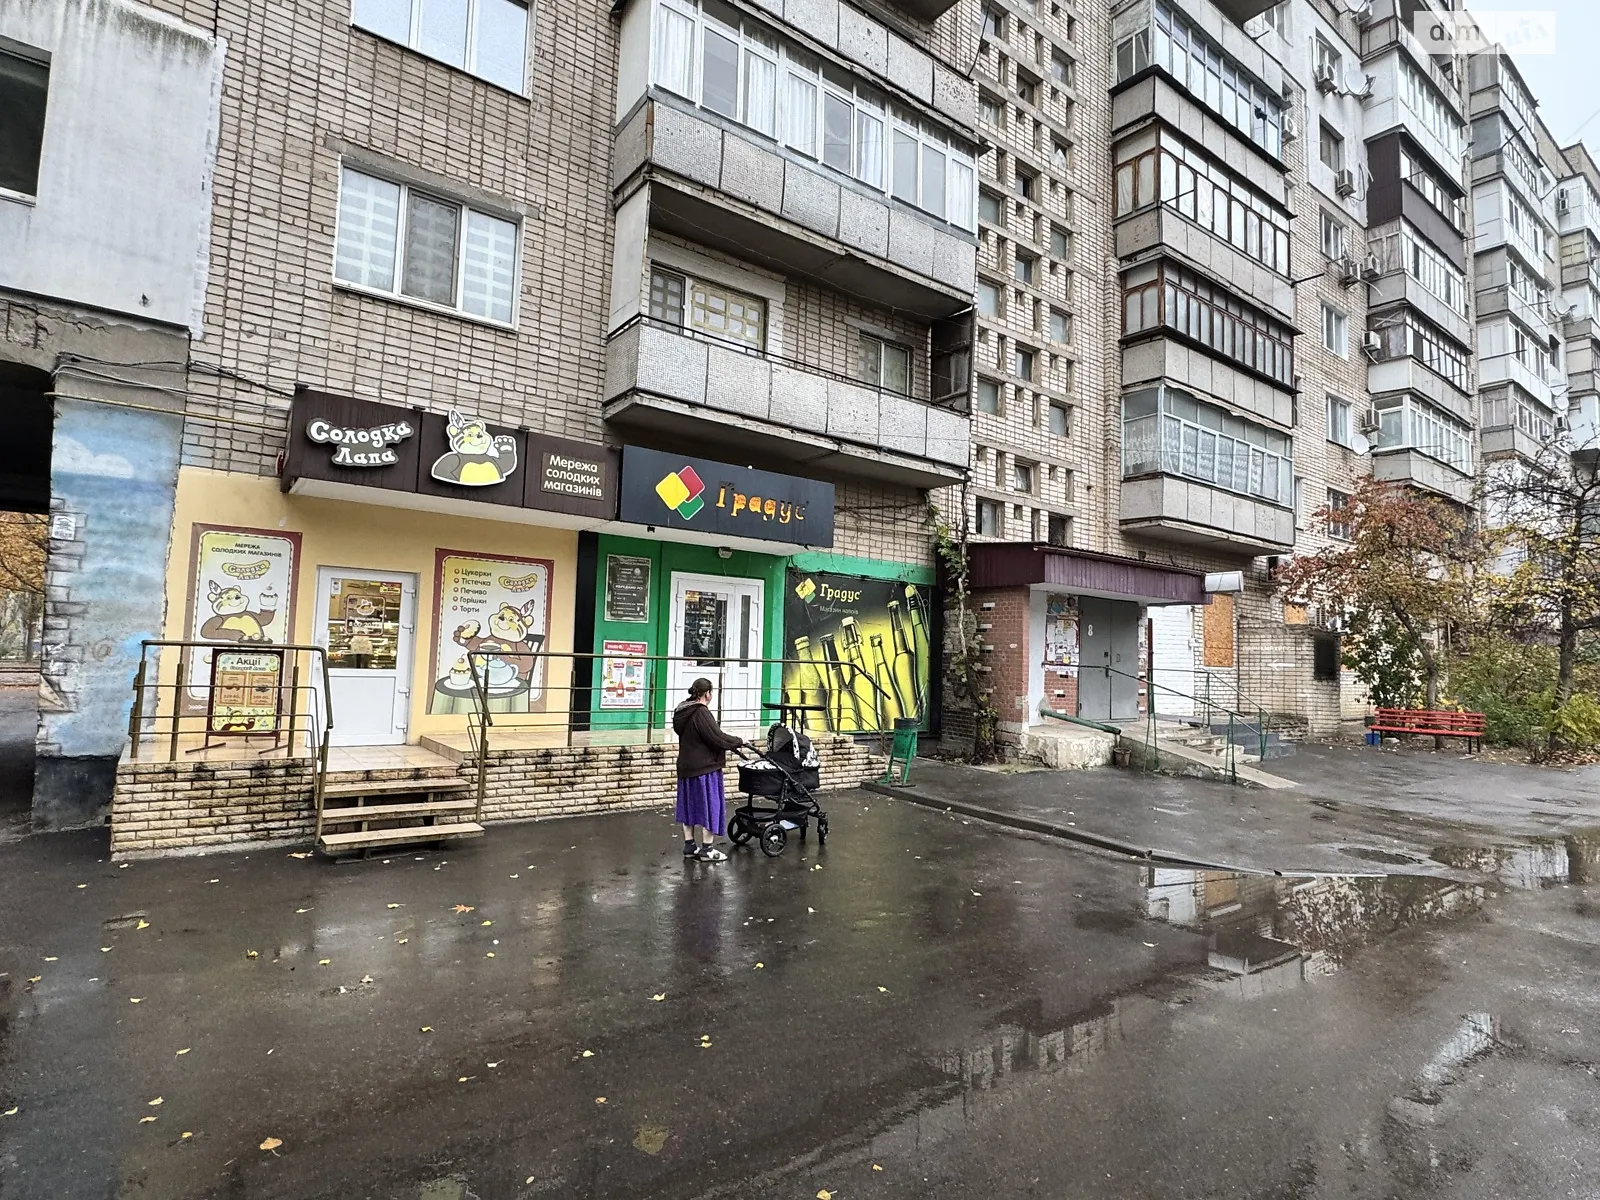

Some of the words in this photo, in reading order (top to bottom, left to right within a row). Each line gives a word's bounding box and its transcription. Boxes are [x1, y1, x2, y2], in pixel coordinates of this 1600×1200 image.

[310, 420, 411, 448] Солодка
[334, 446, 396, 465] Лапа
[549, 454, 598, 473] Мережа
[545, 468, 600, 485] солодких
[543, 480, 602, 497] магазинів
[234, 542, 261, 550] МЕРЕЖА
[211, 547, 247, 555] СОЛОДКИХ
[247, 550, 282, 558] МАГАЗИНІВ
[228, 563, 267, 576] Солодка
[461, 577, 492, 587] Тістечка
[460, 587, 487, 596] Печиво
[819, 583, 862, 603] Градус
[459, 596, 487, 604] Горішки
[460, 605, 480, 613] Торти
[819, 605, 842, 613] Магазин
[1087, 624, 1094, 637] 8
[236, 657, 262, 666] Акції
